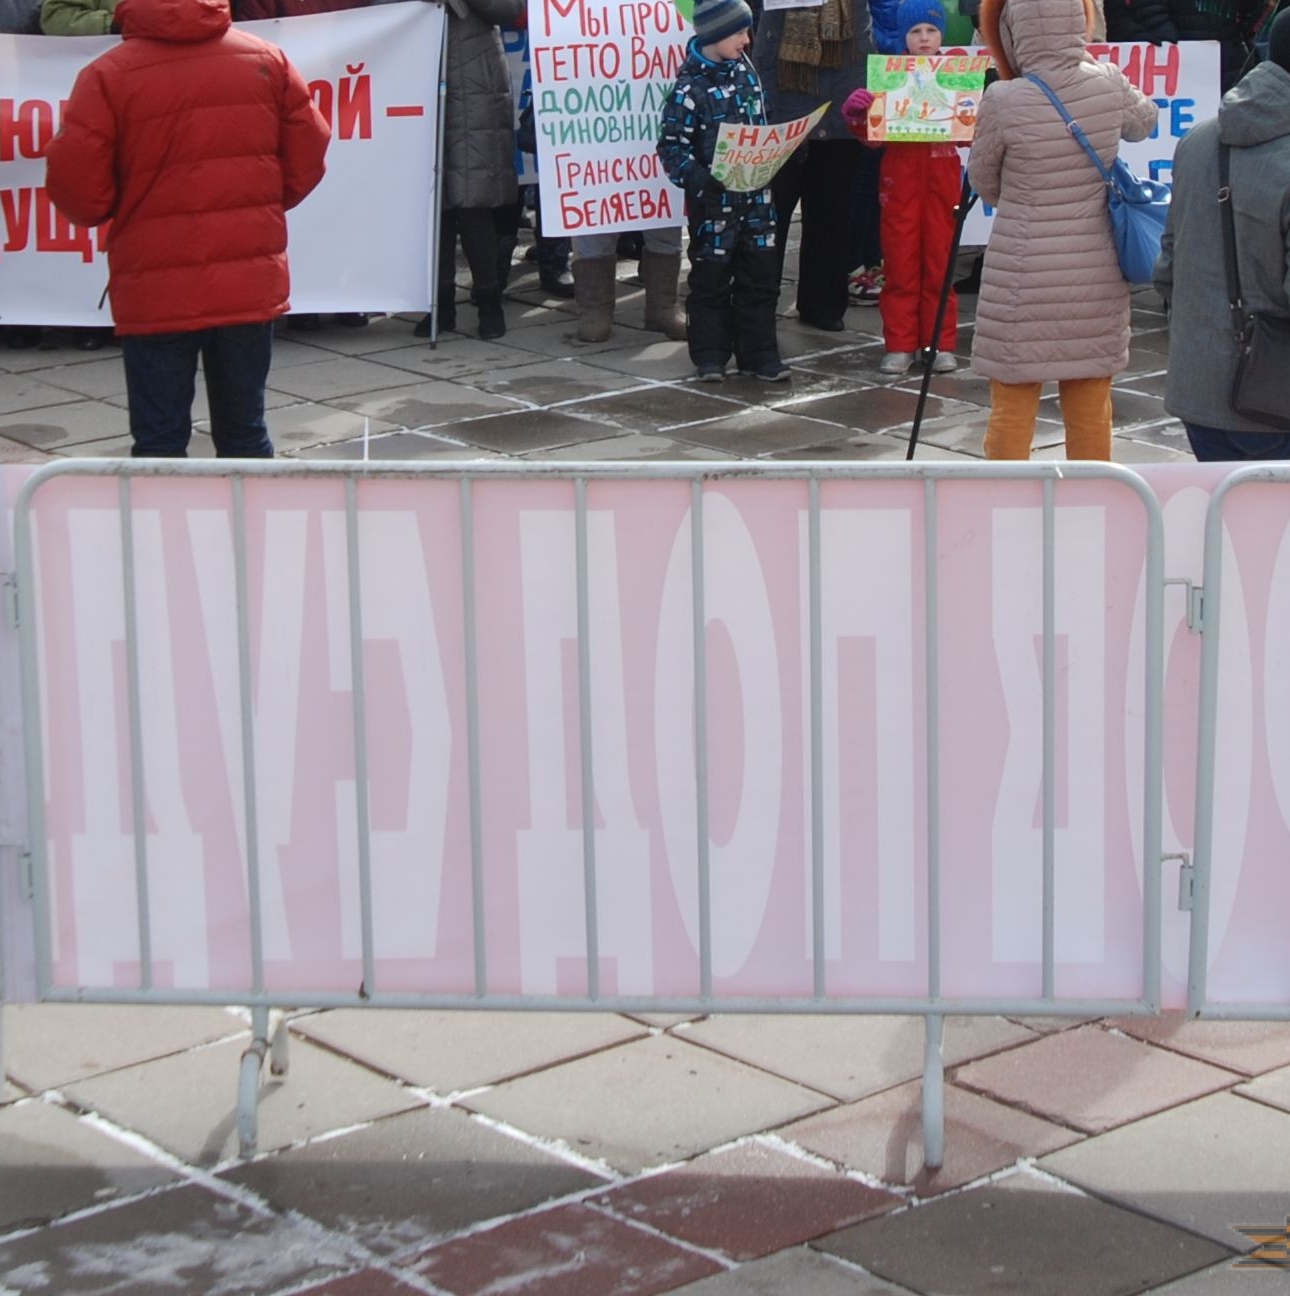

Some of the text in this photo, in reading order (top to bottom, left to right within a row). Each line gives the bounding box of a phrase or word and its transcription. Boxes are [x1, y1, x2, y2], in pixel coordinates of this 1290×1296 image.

[534, 42, 621, 84] ГЕТТО
[538, 79, 632, 117] ДОЛОЙ
[737, 116, 810, 147] НАШ
